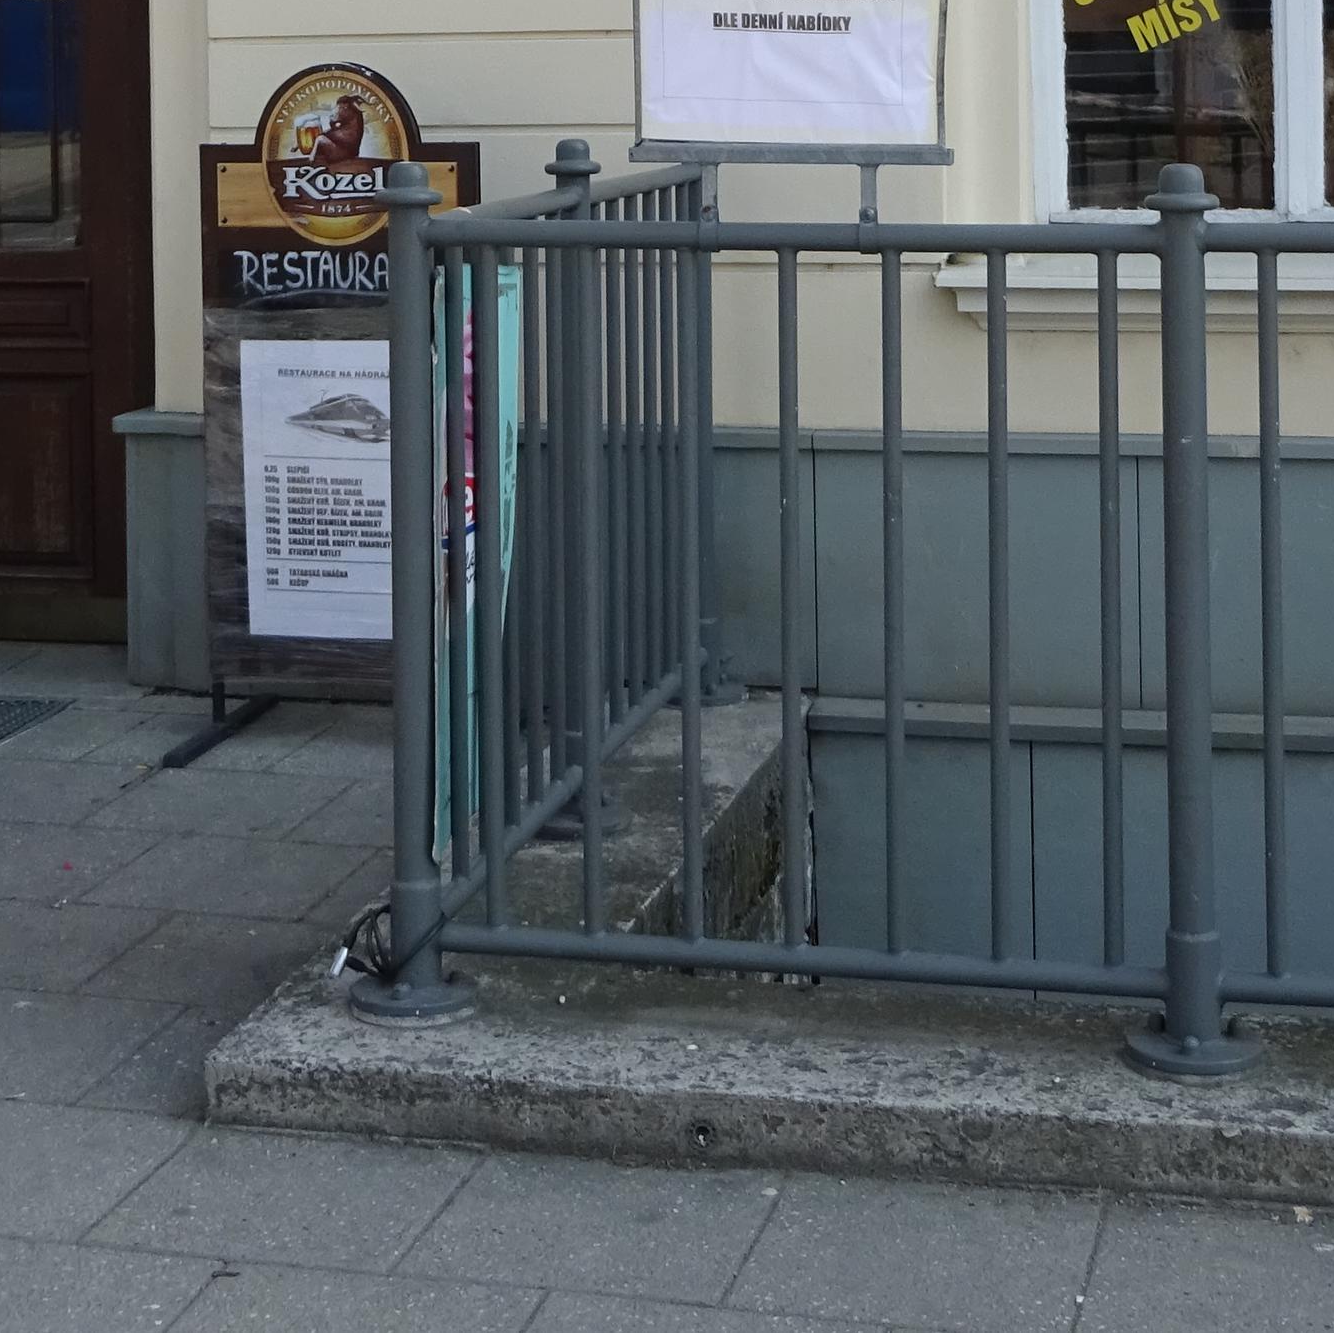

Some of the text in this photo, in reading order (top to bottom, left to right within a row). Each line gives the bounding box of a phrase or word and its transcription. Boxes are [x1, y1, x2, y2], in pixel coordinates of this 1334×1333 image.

[713, 12, 851, 32] DLE DENNÍ NABÍDKY
[283, 166, 386, 200] Kozel
[321, 204, 351, 213] 1874
